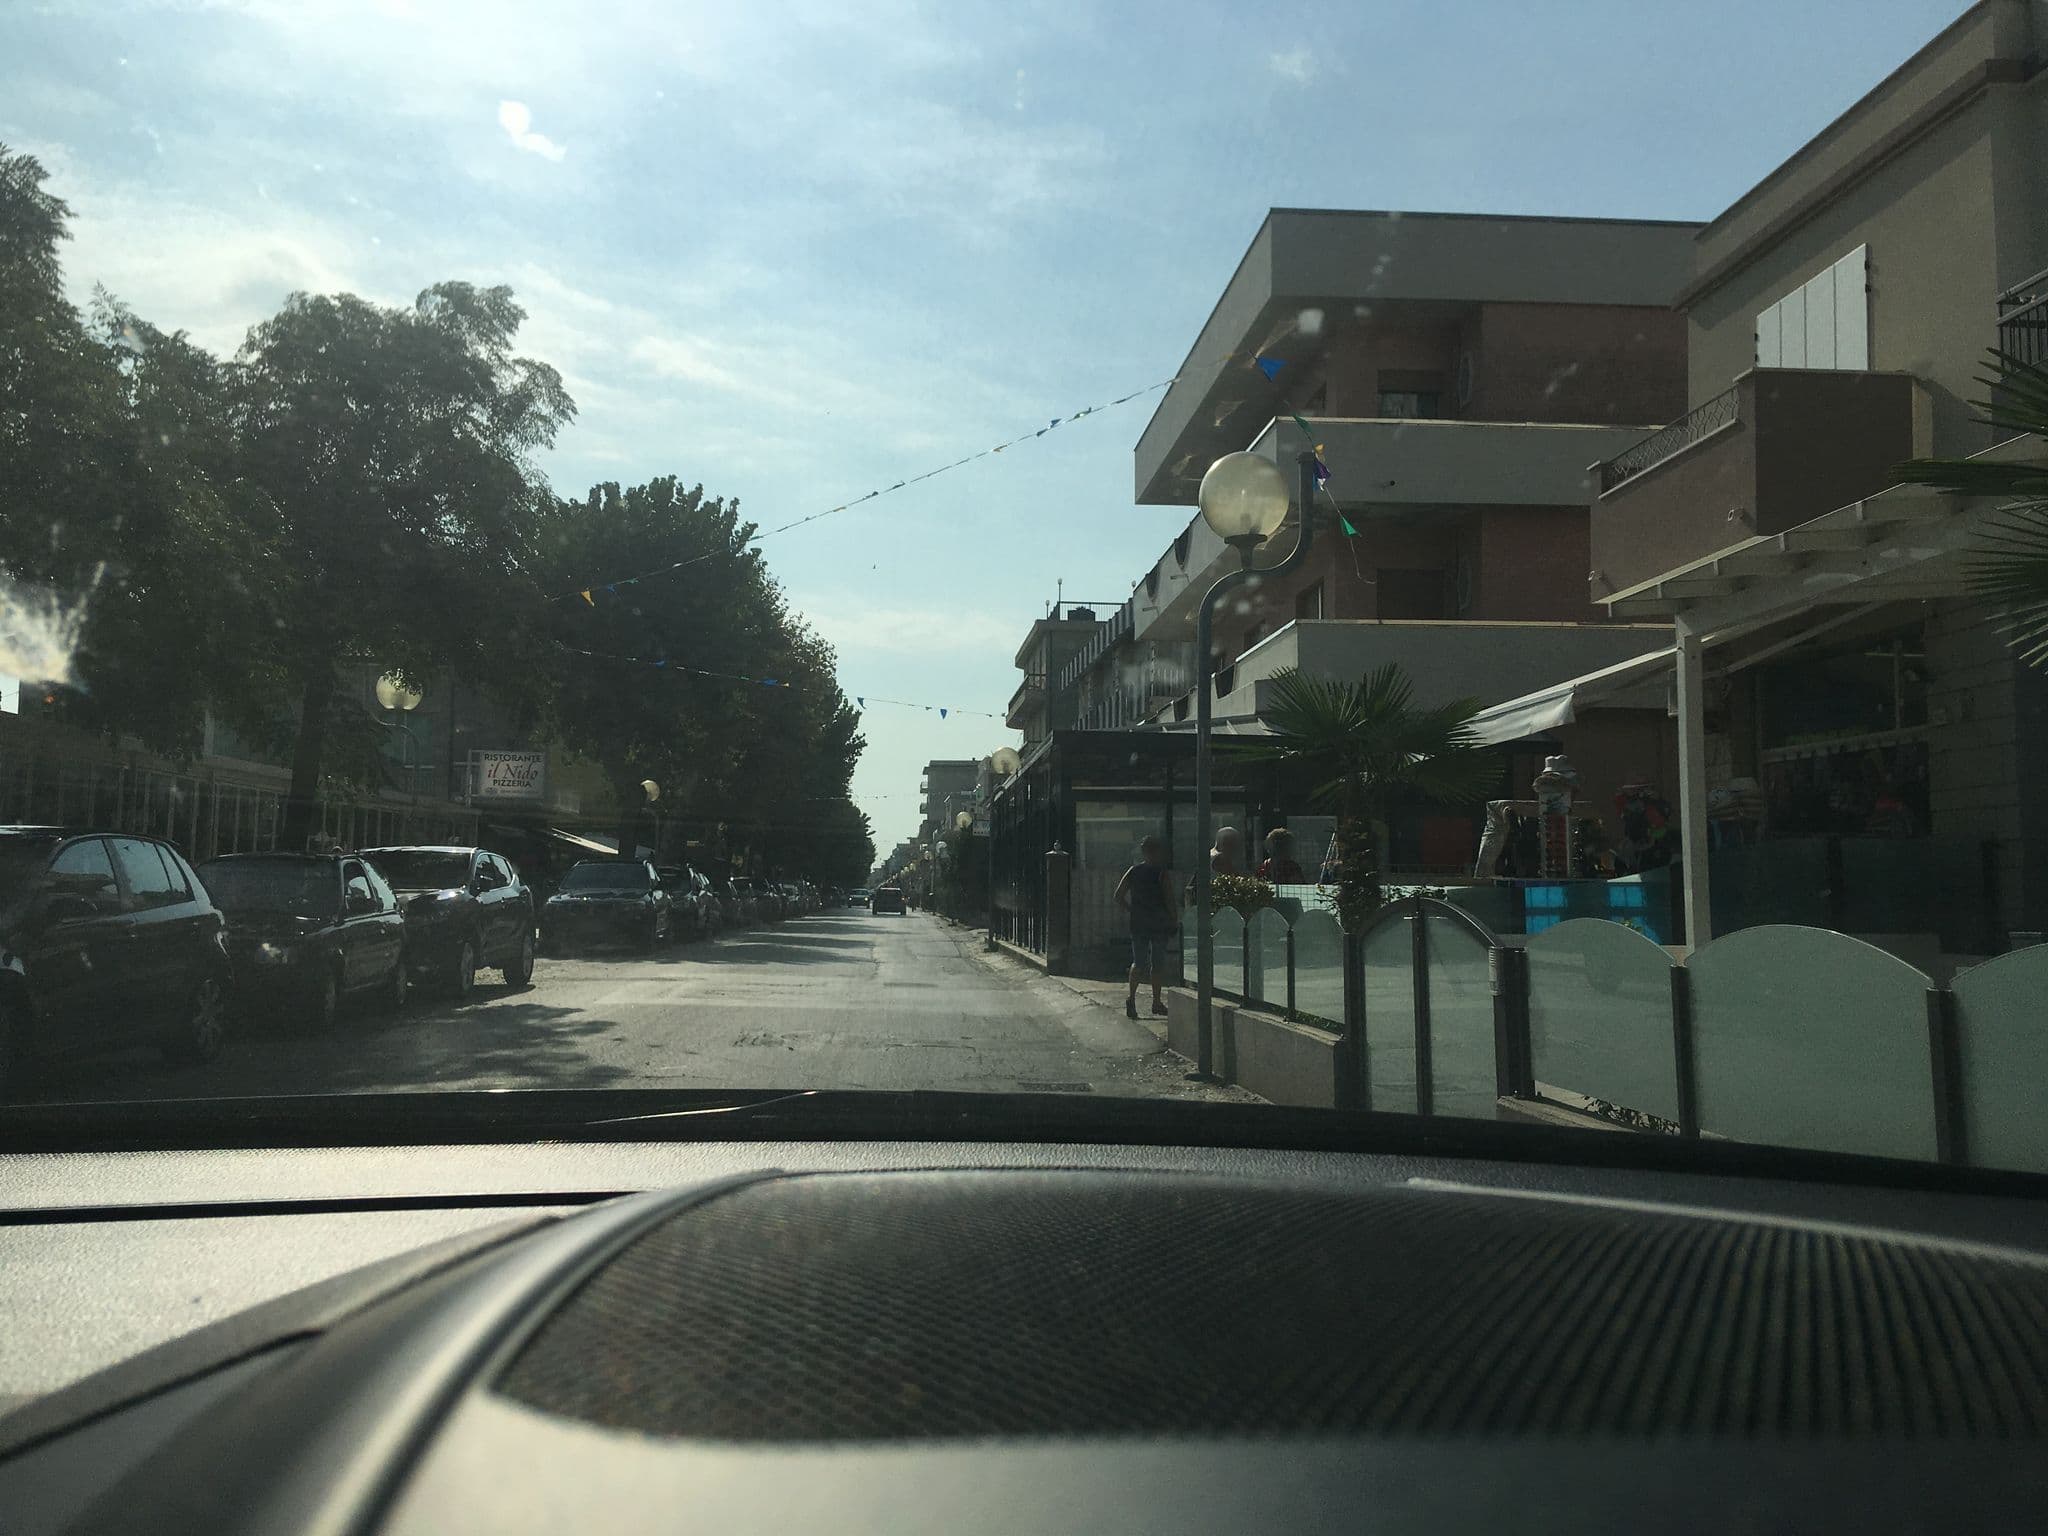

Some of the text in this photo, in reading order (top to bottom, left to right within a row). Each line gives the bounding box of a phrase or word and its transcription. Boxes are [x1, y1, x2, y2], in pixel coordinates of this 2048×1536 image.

[484, 754, 542, 763] RISTORANTE
[487, 760, 538, 780] il Nido
[493, 779, 532, 787] PIZZERIA
